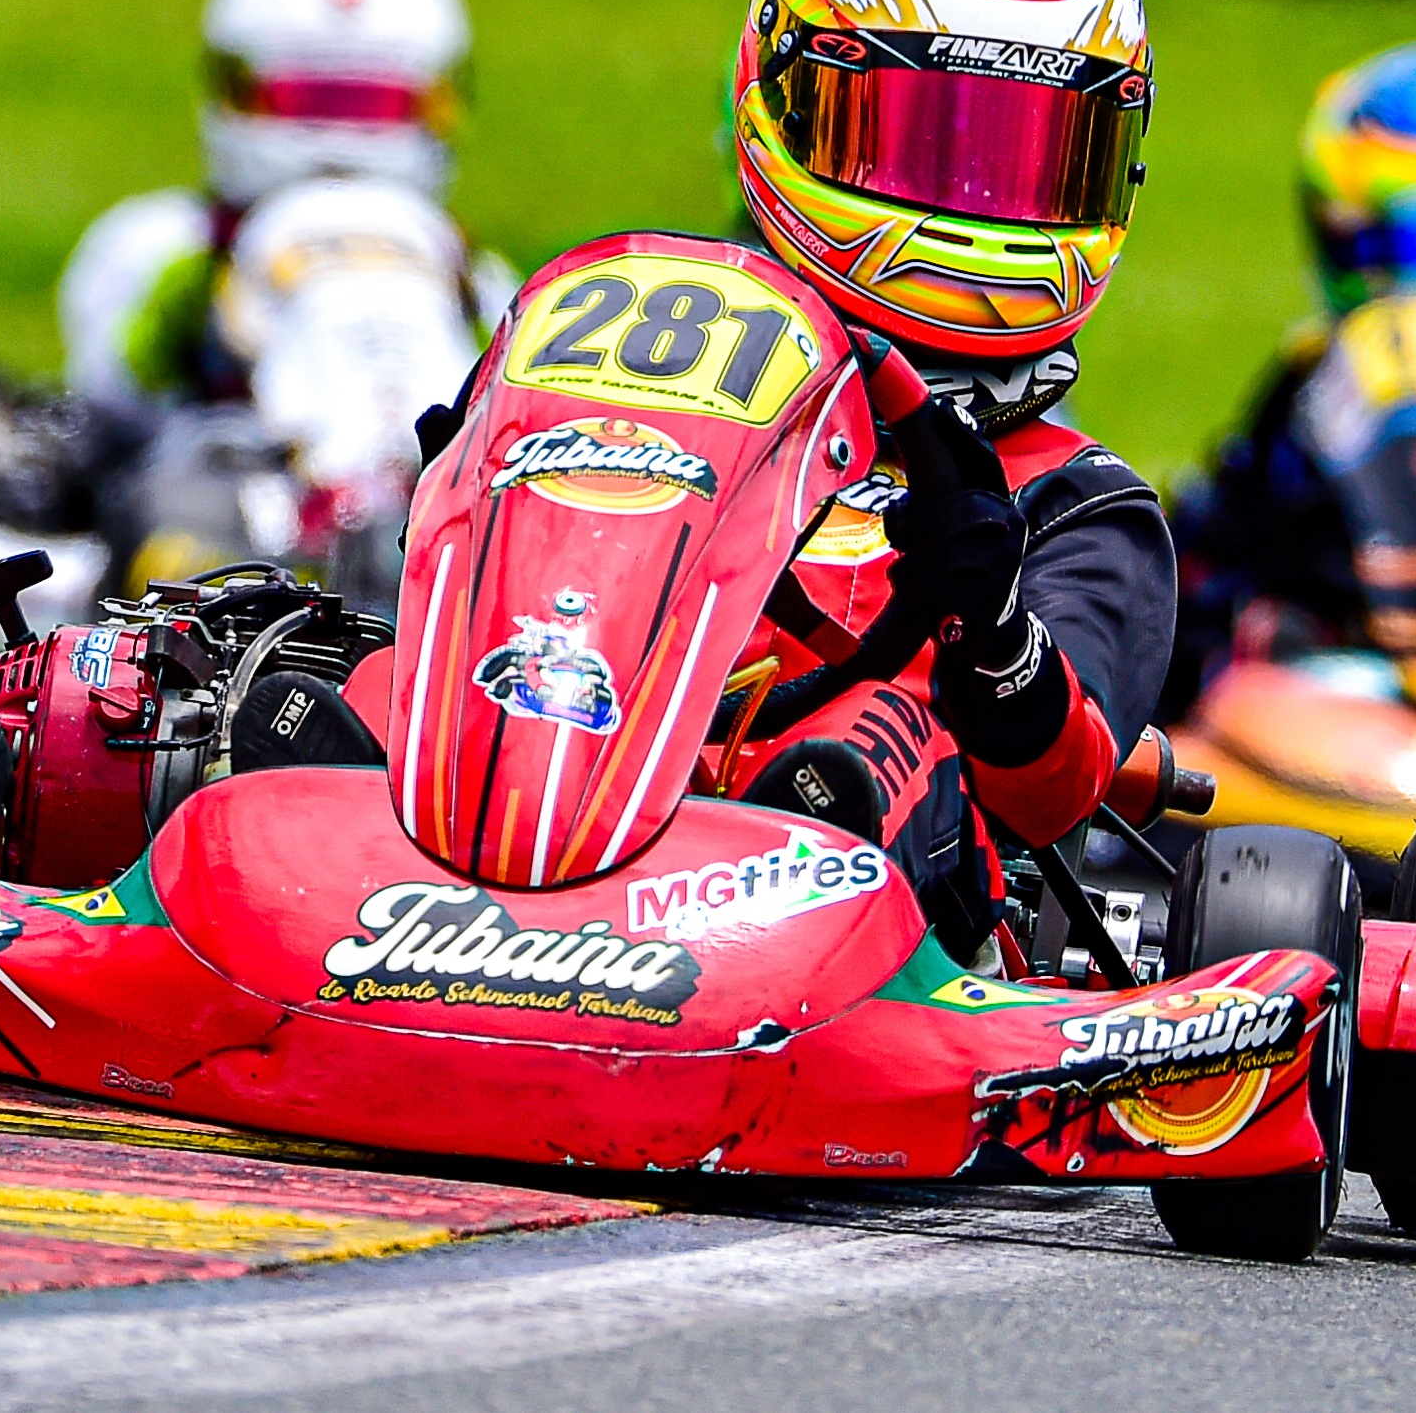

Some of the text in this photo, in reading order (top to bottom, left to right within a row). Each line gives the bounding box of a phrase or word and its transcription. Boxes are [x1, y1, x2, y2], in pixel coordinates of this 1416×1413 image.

[524, 274, 791, 411] 281
[276, 692, 307, 736] OMP
[795, 768, 830, 808] OMP
[353, 978, 439, 1001] Ricardo
[444, 981, 571, 1011] Schincariol
[577, 990, 681, 1024] Tarchiani
